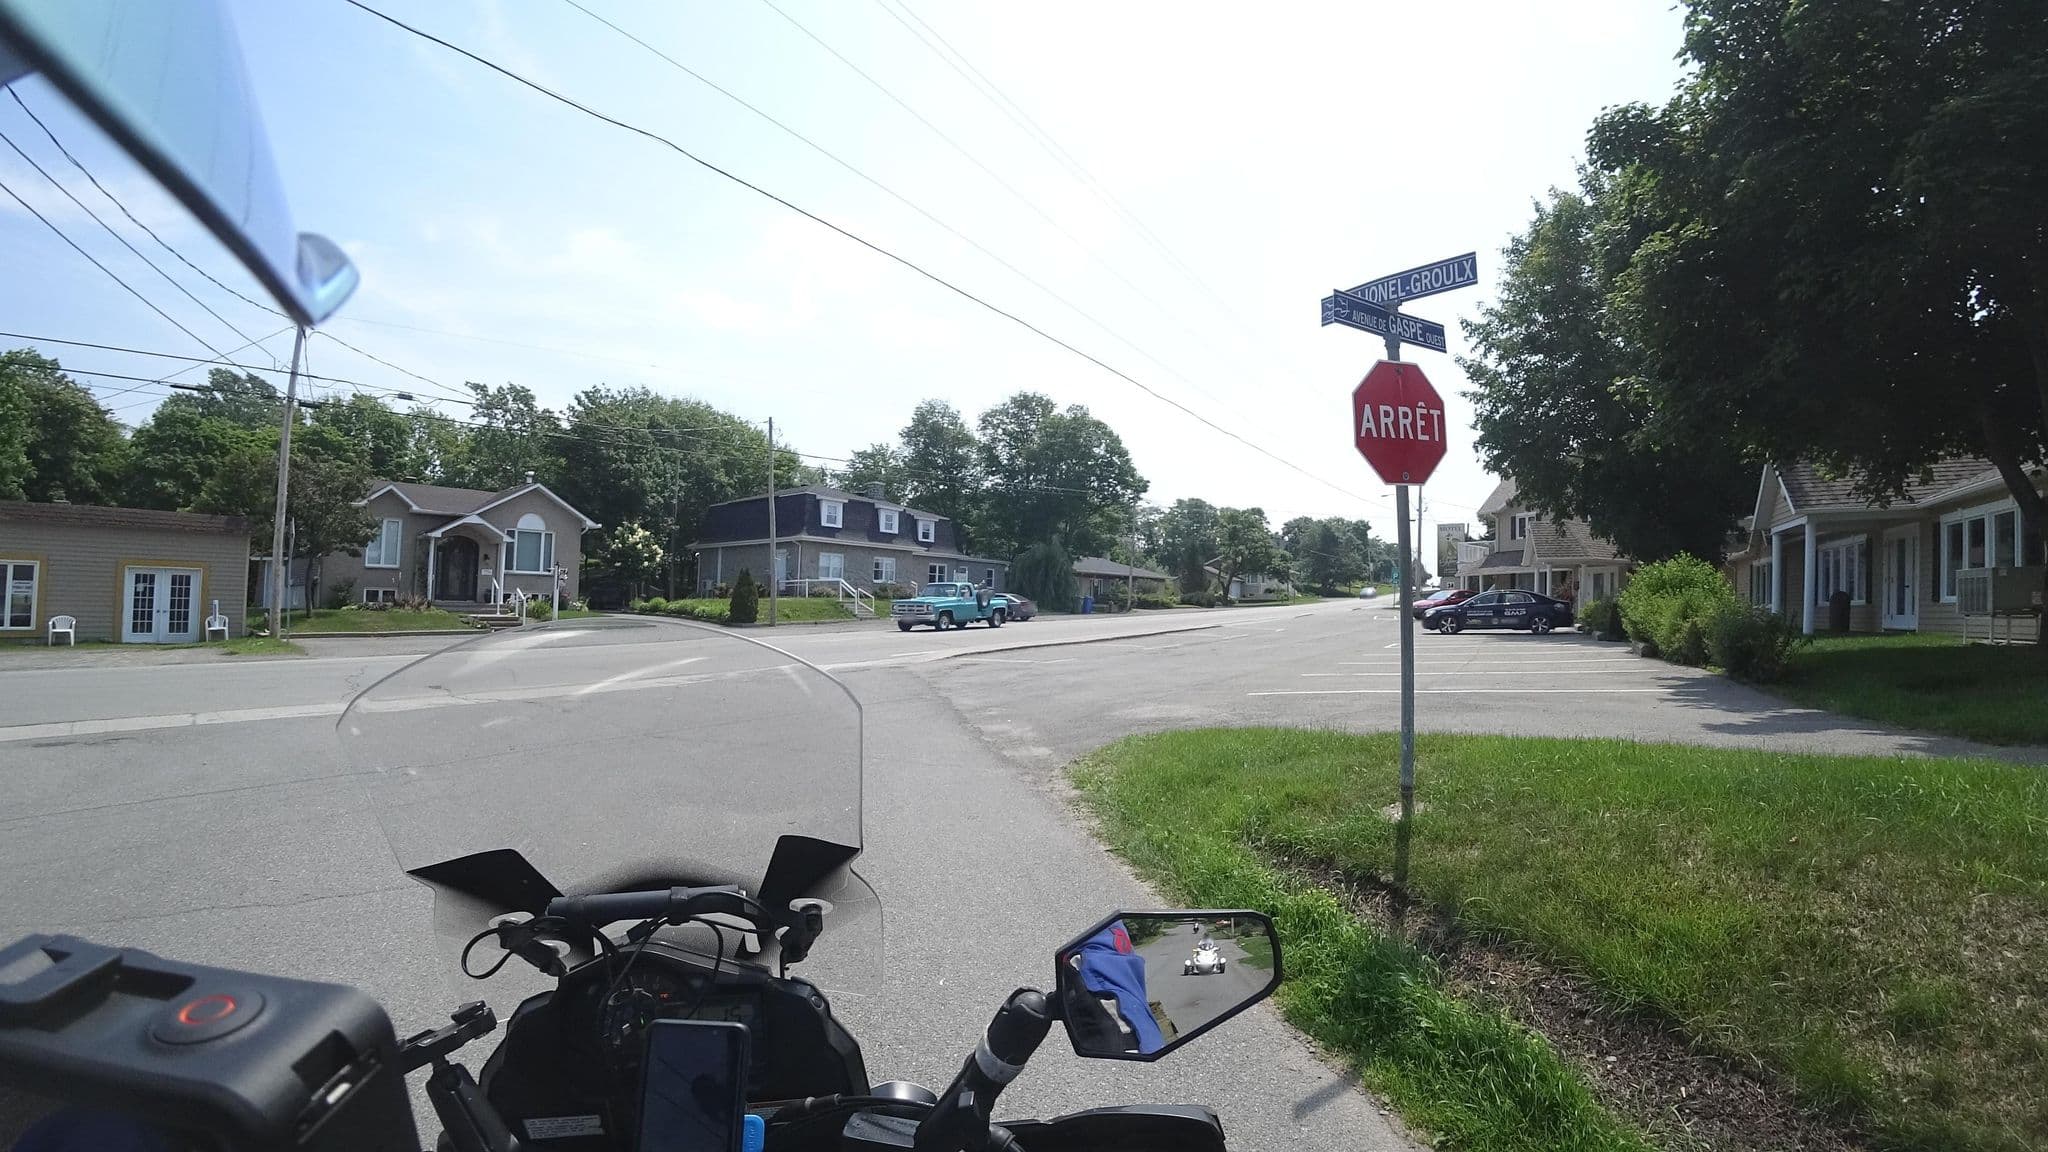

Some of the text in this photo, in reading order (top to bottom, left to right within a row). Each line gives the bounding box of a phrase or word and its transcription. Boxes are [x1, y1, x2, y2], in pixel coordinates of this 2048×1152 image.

[1352, 310, 1378, 329] AVENUE
[1379, 318, 1387, 331] DE
[1426, 332, 1445, 347] OUEST
[1360, 401, 1441, 442] ARRÊT
